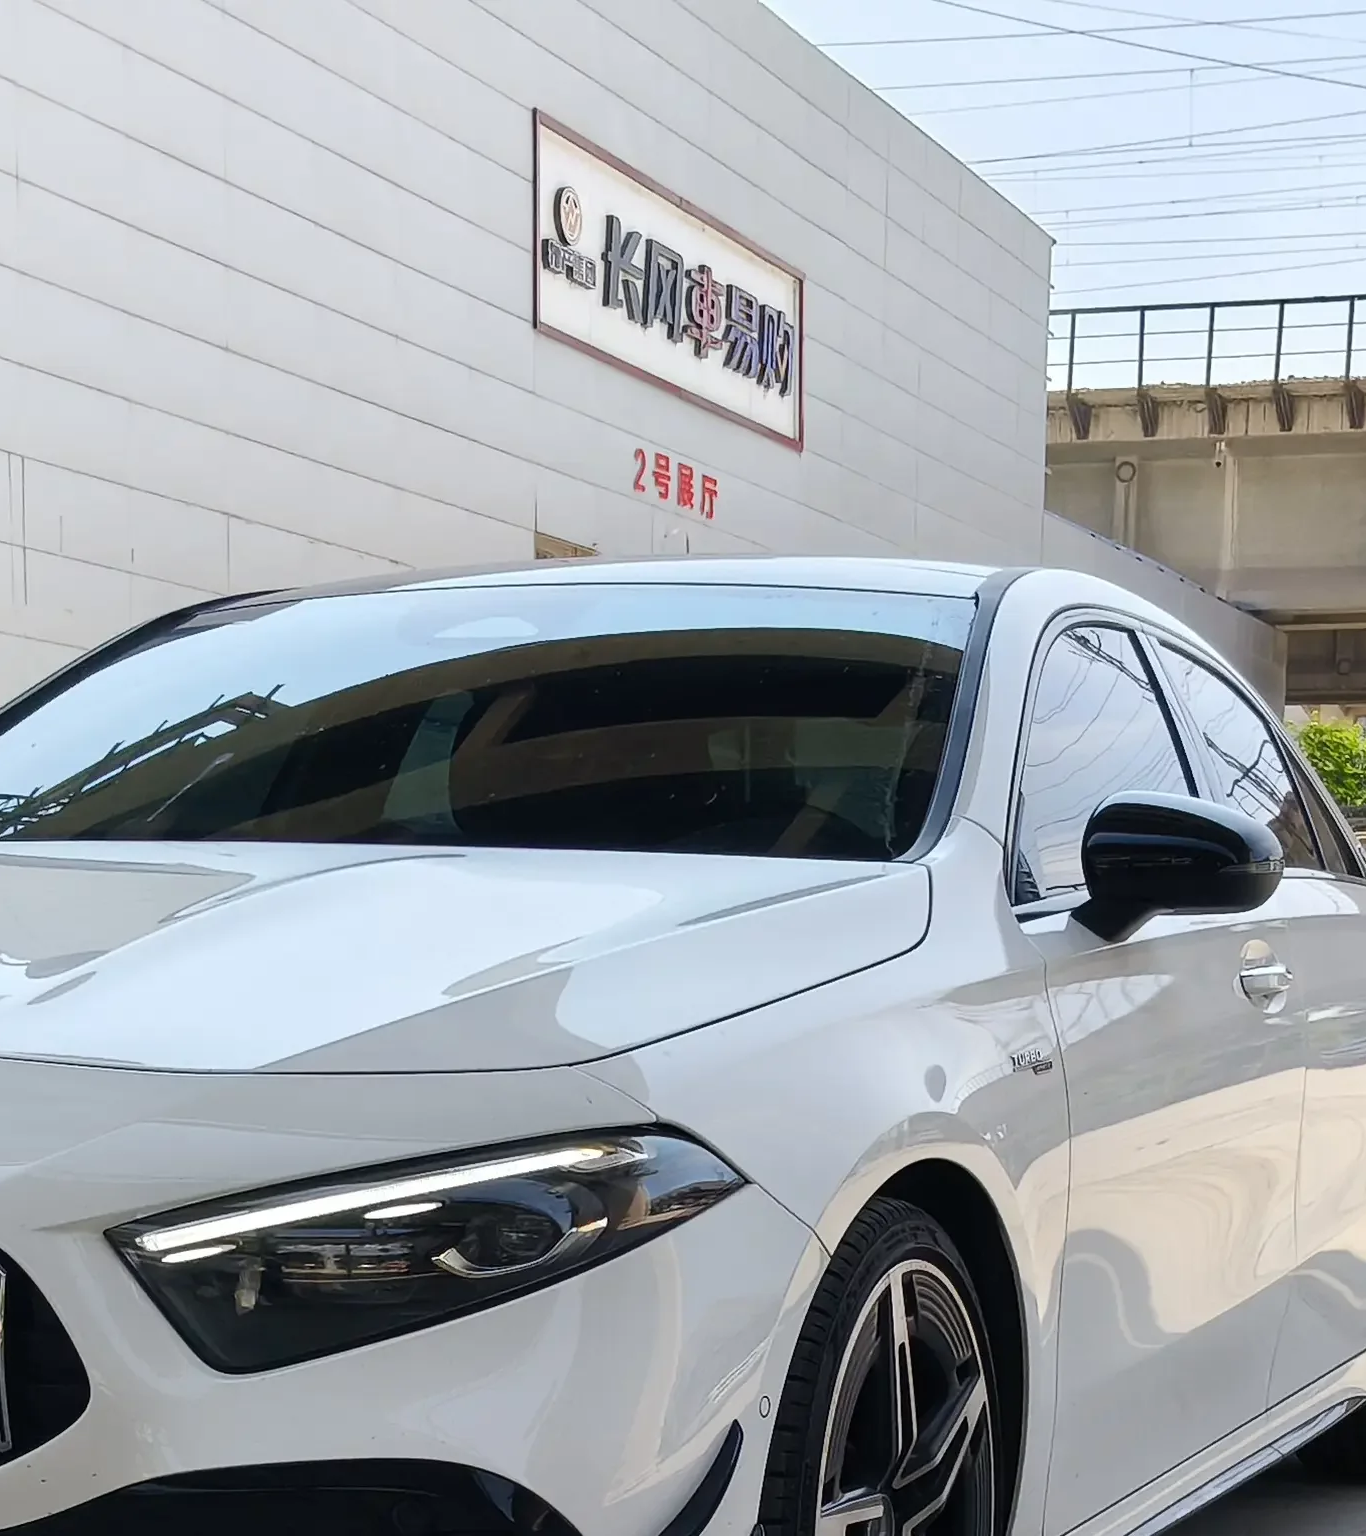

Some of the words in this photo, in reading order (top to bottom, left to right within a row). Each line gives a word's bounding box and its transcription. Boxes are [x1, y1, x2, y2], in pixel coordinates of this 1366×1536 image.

[633, 448, 718, 520] 2号展厅
[1010, 1050, 1043, 1068] TURBO
